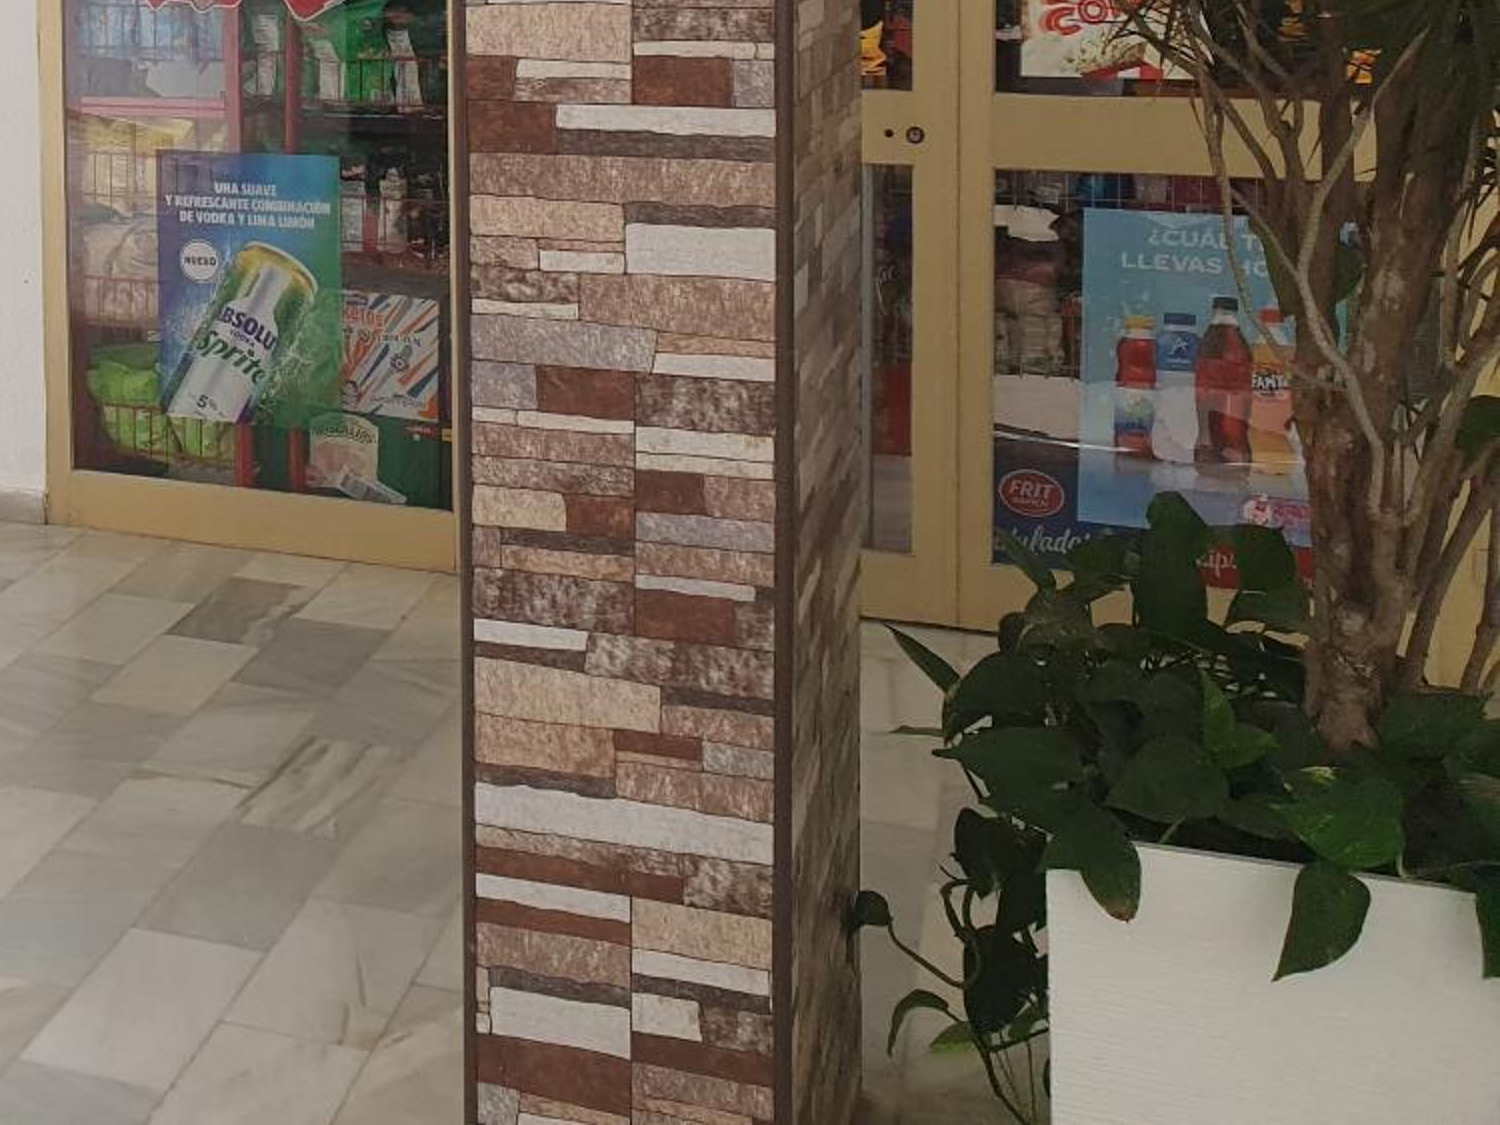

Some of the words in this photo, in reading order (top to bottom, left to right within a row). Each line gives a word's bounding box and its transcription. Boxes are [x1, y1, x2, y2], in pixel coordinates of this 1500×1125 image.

[214, 181, 239, 194] UNA
[165, 194, 175, 207] Y
[179, 209, 196, 223] DE
[197, 210, 235, 225] VODKA
[238, 213, 246, 226] Y
[1121, 250, 1222, 275] LLEVAS
[218, 305, 277, 351] BSOLU
[1009, 479, 1054, 500] FRIT
